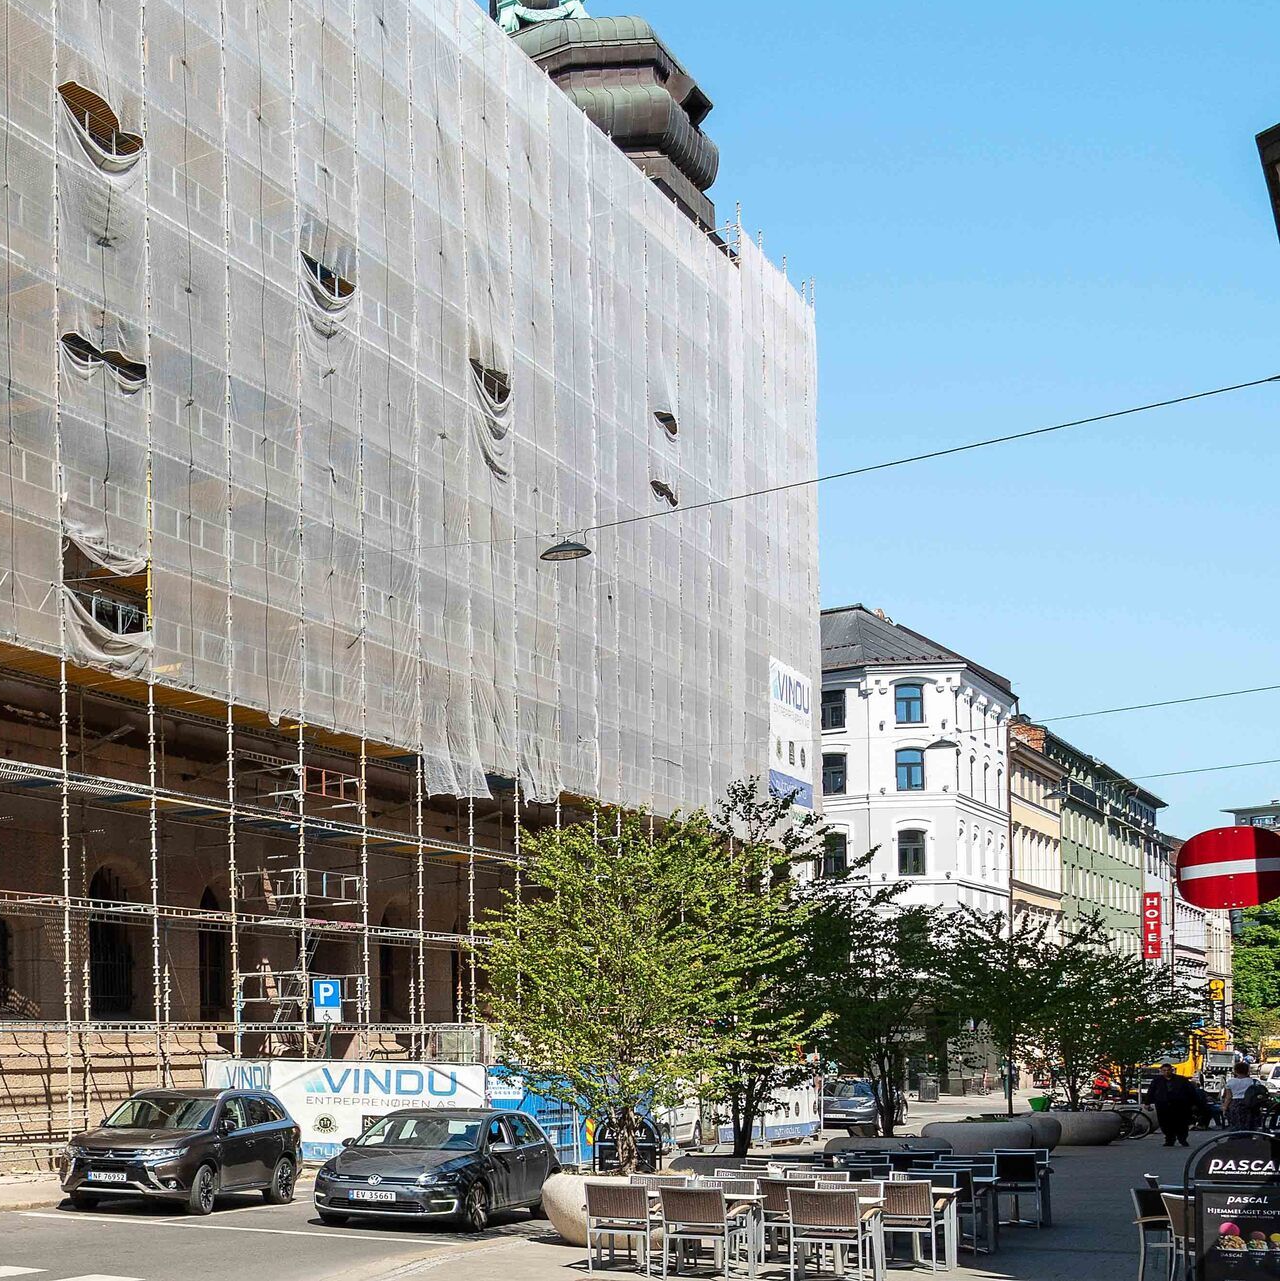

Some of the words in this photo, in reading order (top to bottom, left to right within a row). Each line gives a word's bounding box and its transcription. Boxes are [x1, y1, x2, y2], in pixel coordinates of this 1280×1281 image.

[778, 670, 810, 714] VINDU
[1145, 897, 1159, 954] HOTEL
[320, 984, 334, 1005] P
[225, 1066, 271, 1089] VINDU
[322, 1068, 458, 1096] VINDU
[306, 1096, 430, 1108] ENTREPRENØREN
[1208, 1159, 1280, 1174] PASCA
[1226, 1195, 1268, 1205] PASCAL
